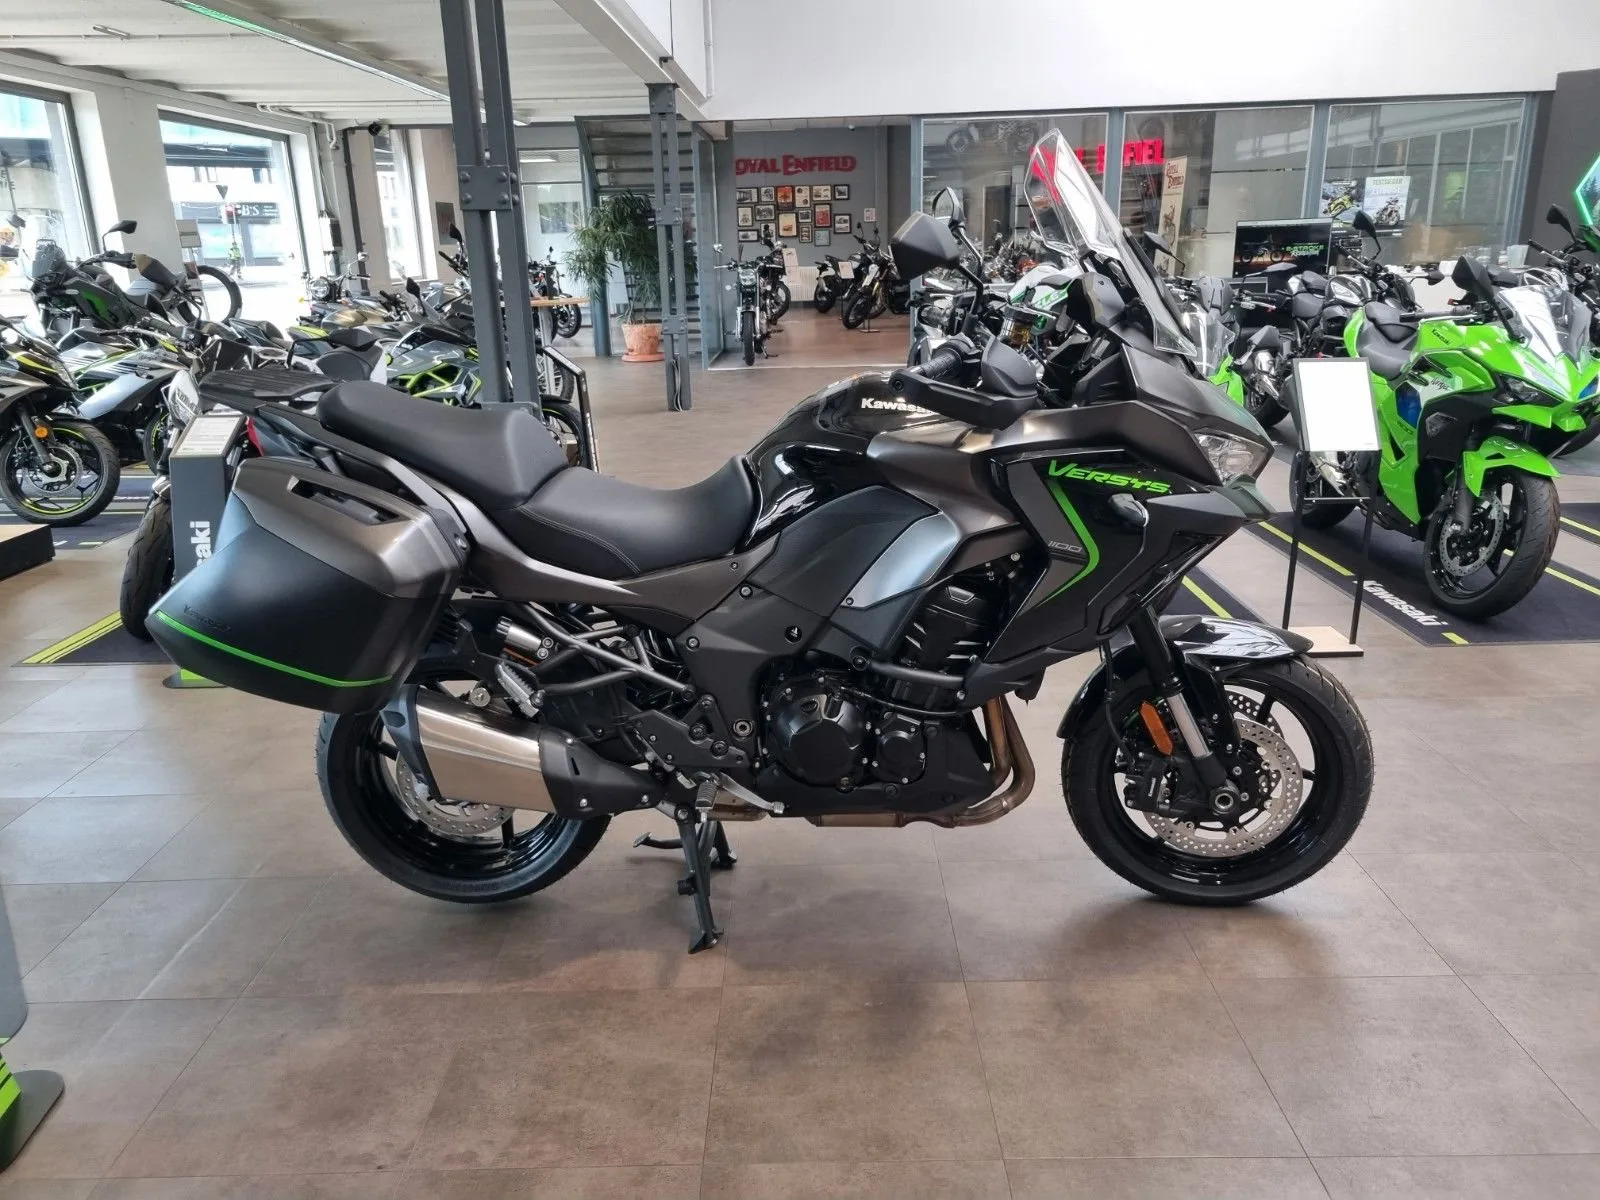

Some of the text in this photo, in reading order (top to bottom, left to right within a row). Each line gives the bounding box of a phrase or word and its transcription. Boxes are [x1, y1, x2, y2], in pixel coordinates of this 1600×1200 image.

[736, 157, 781, 175] OYAL
[1048, 459, 1171, 494] VERSYS
[1048, 540, 1082, 553] 1100
